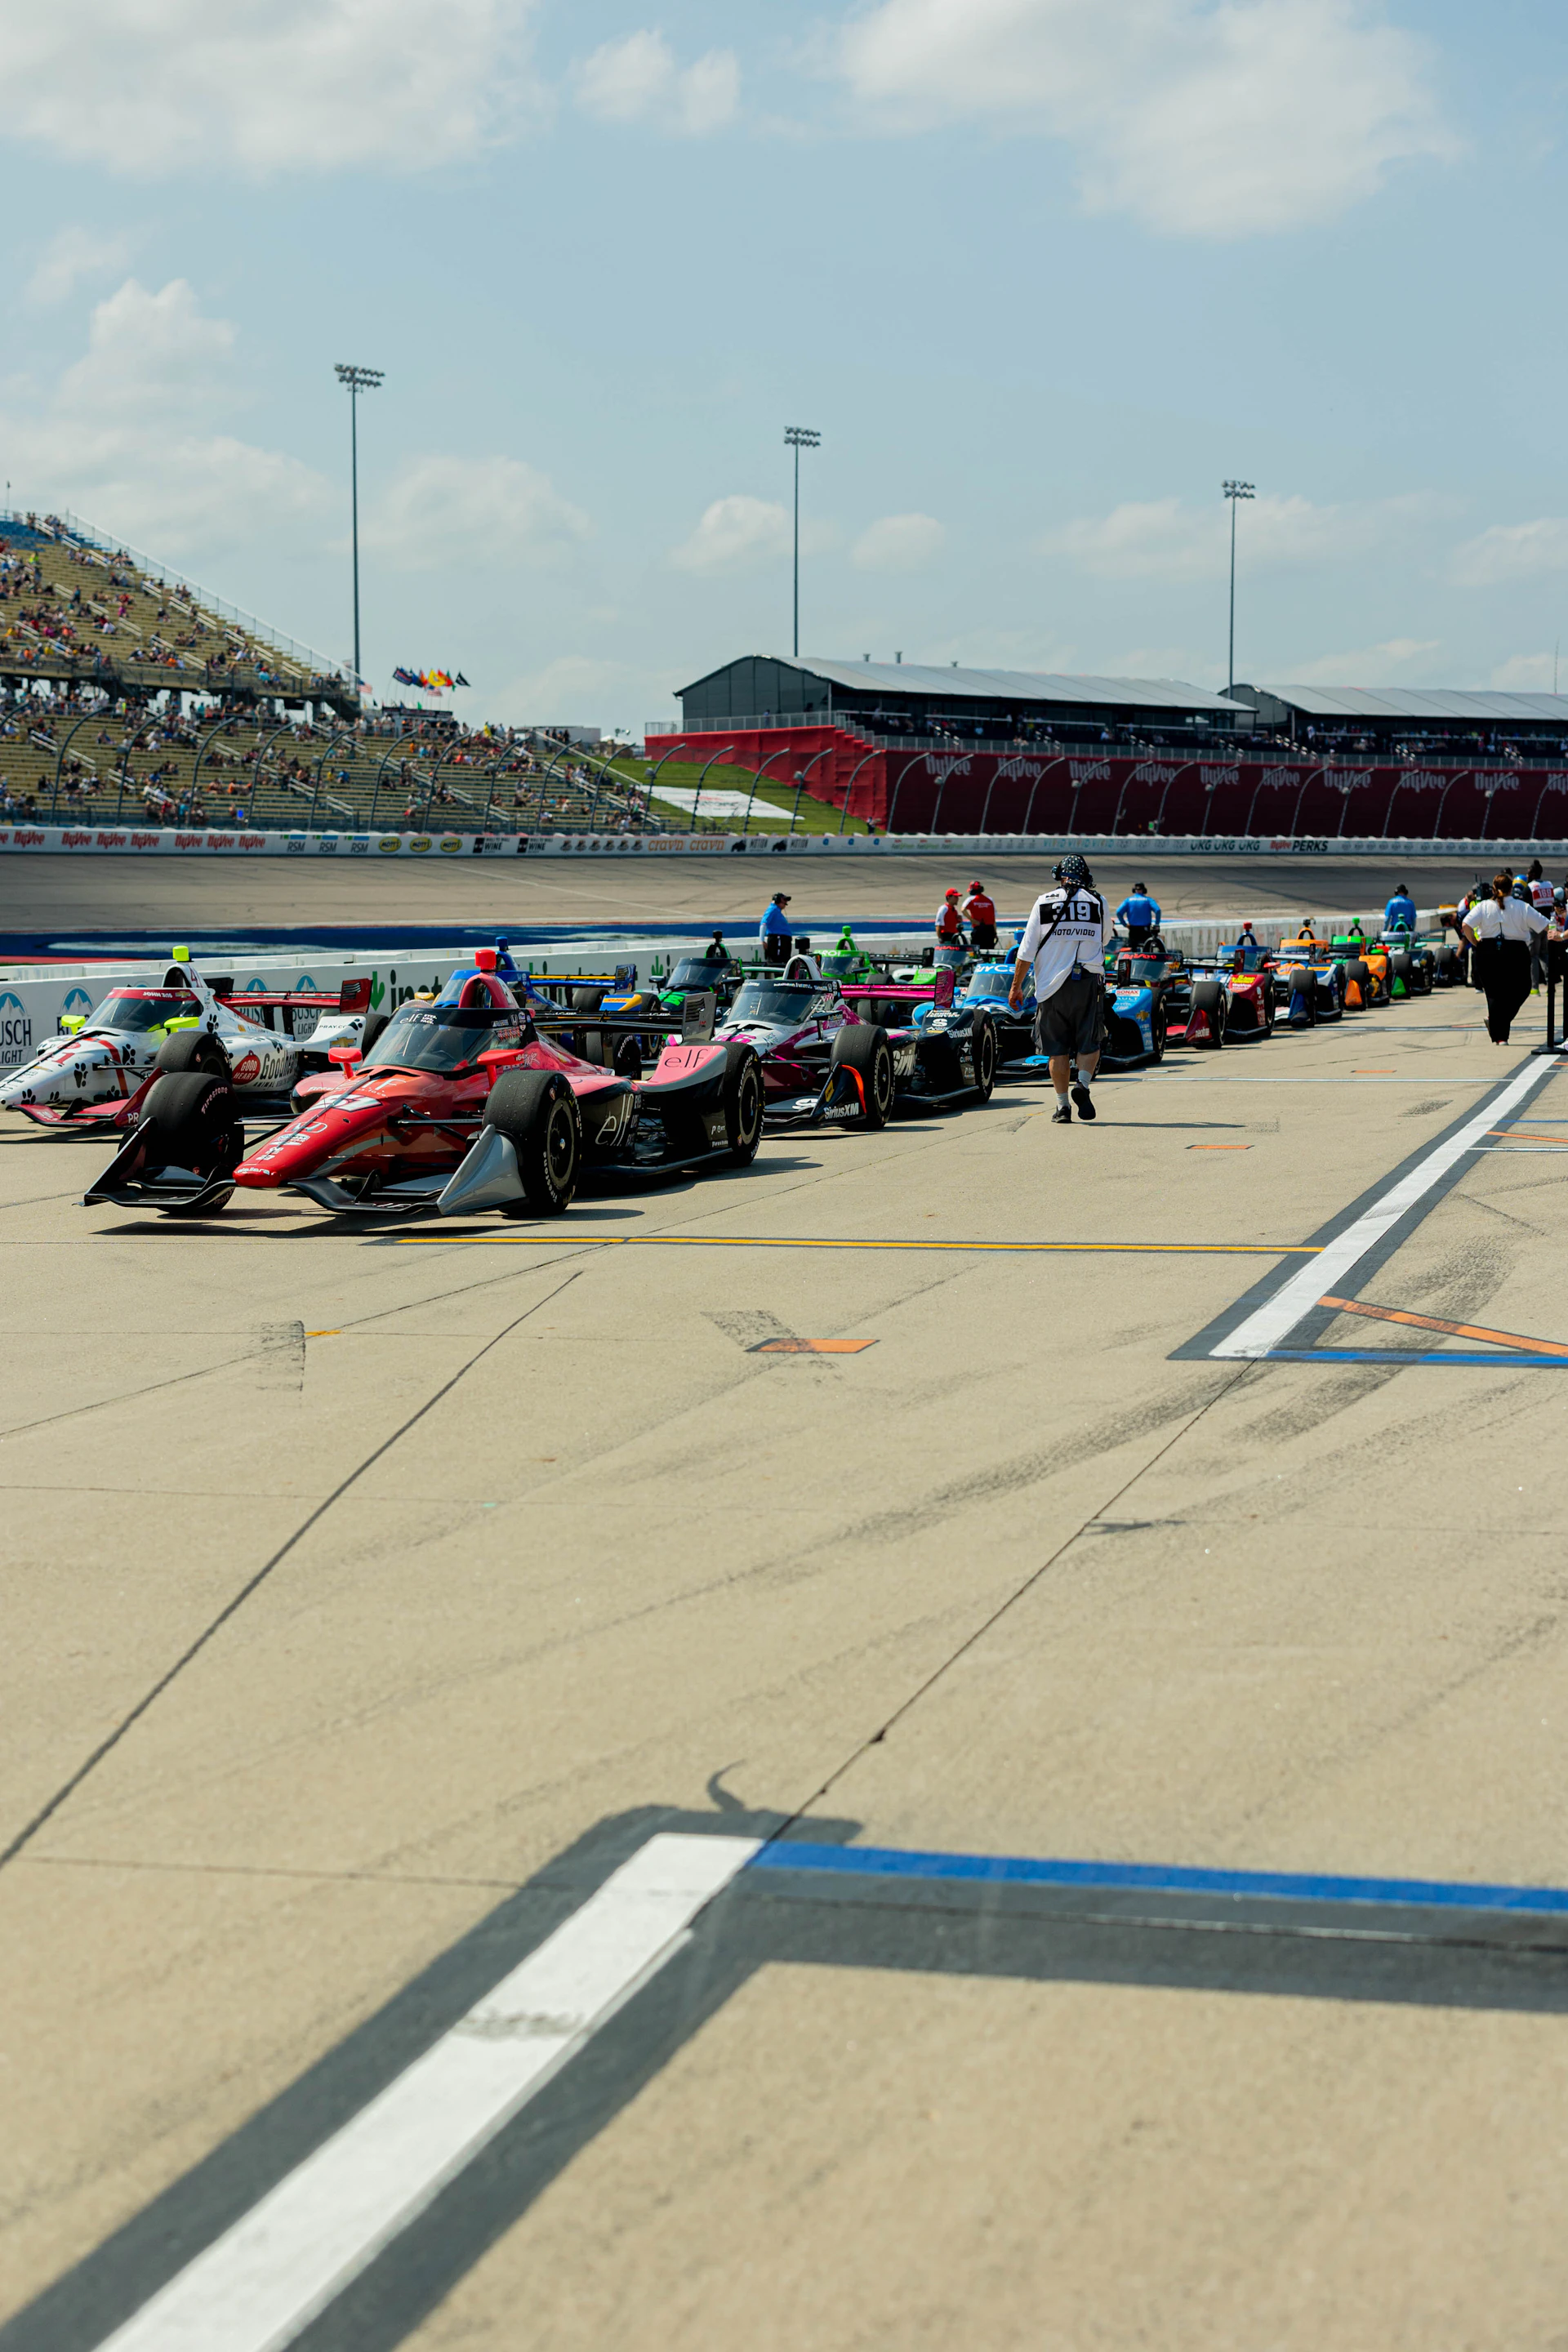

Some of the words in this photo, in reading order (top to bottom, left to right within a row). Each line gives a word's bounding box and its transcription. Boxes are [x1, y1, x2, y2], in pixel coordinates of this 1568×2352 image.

[287, 841, 305, 852] RSM
[318, 842, 337, 853] RSM
[350, 842, 369, 853] RSM
[484, 842, 503, 850] WINE
[528, 843, 546, 851] WINE
[1292, 840, 1328, 851] PERKS
[1052, 902, 1091, 921] 319
[1052, 928, 1095, 937] HOTO/VIDEO
[297, 1022, 316, 1035] LIGHT
[947, 1027, 973, 1039] SiriusXM
[617, 1035, 634, 1058] Firestone
[0, 1049, 23, 1064] IGHT
[241, 1059, 258, 1071] GOOD
[234, 1072, 256, 1080] HEART
[201, 1086, 229, 1114] Firestone
[823, 1102, 860, 1120] SiriusXM
